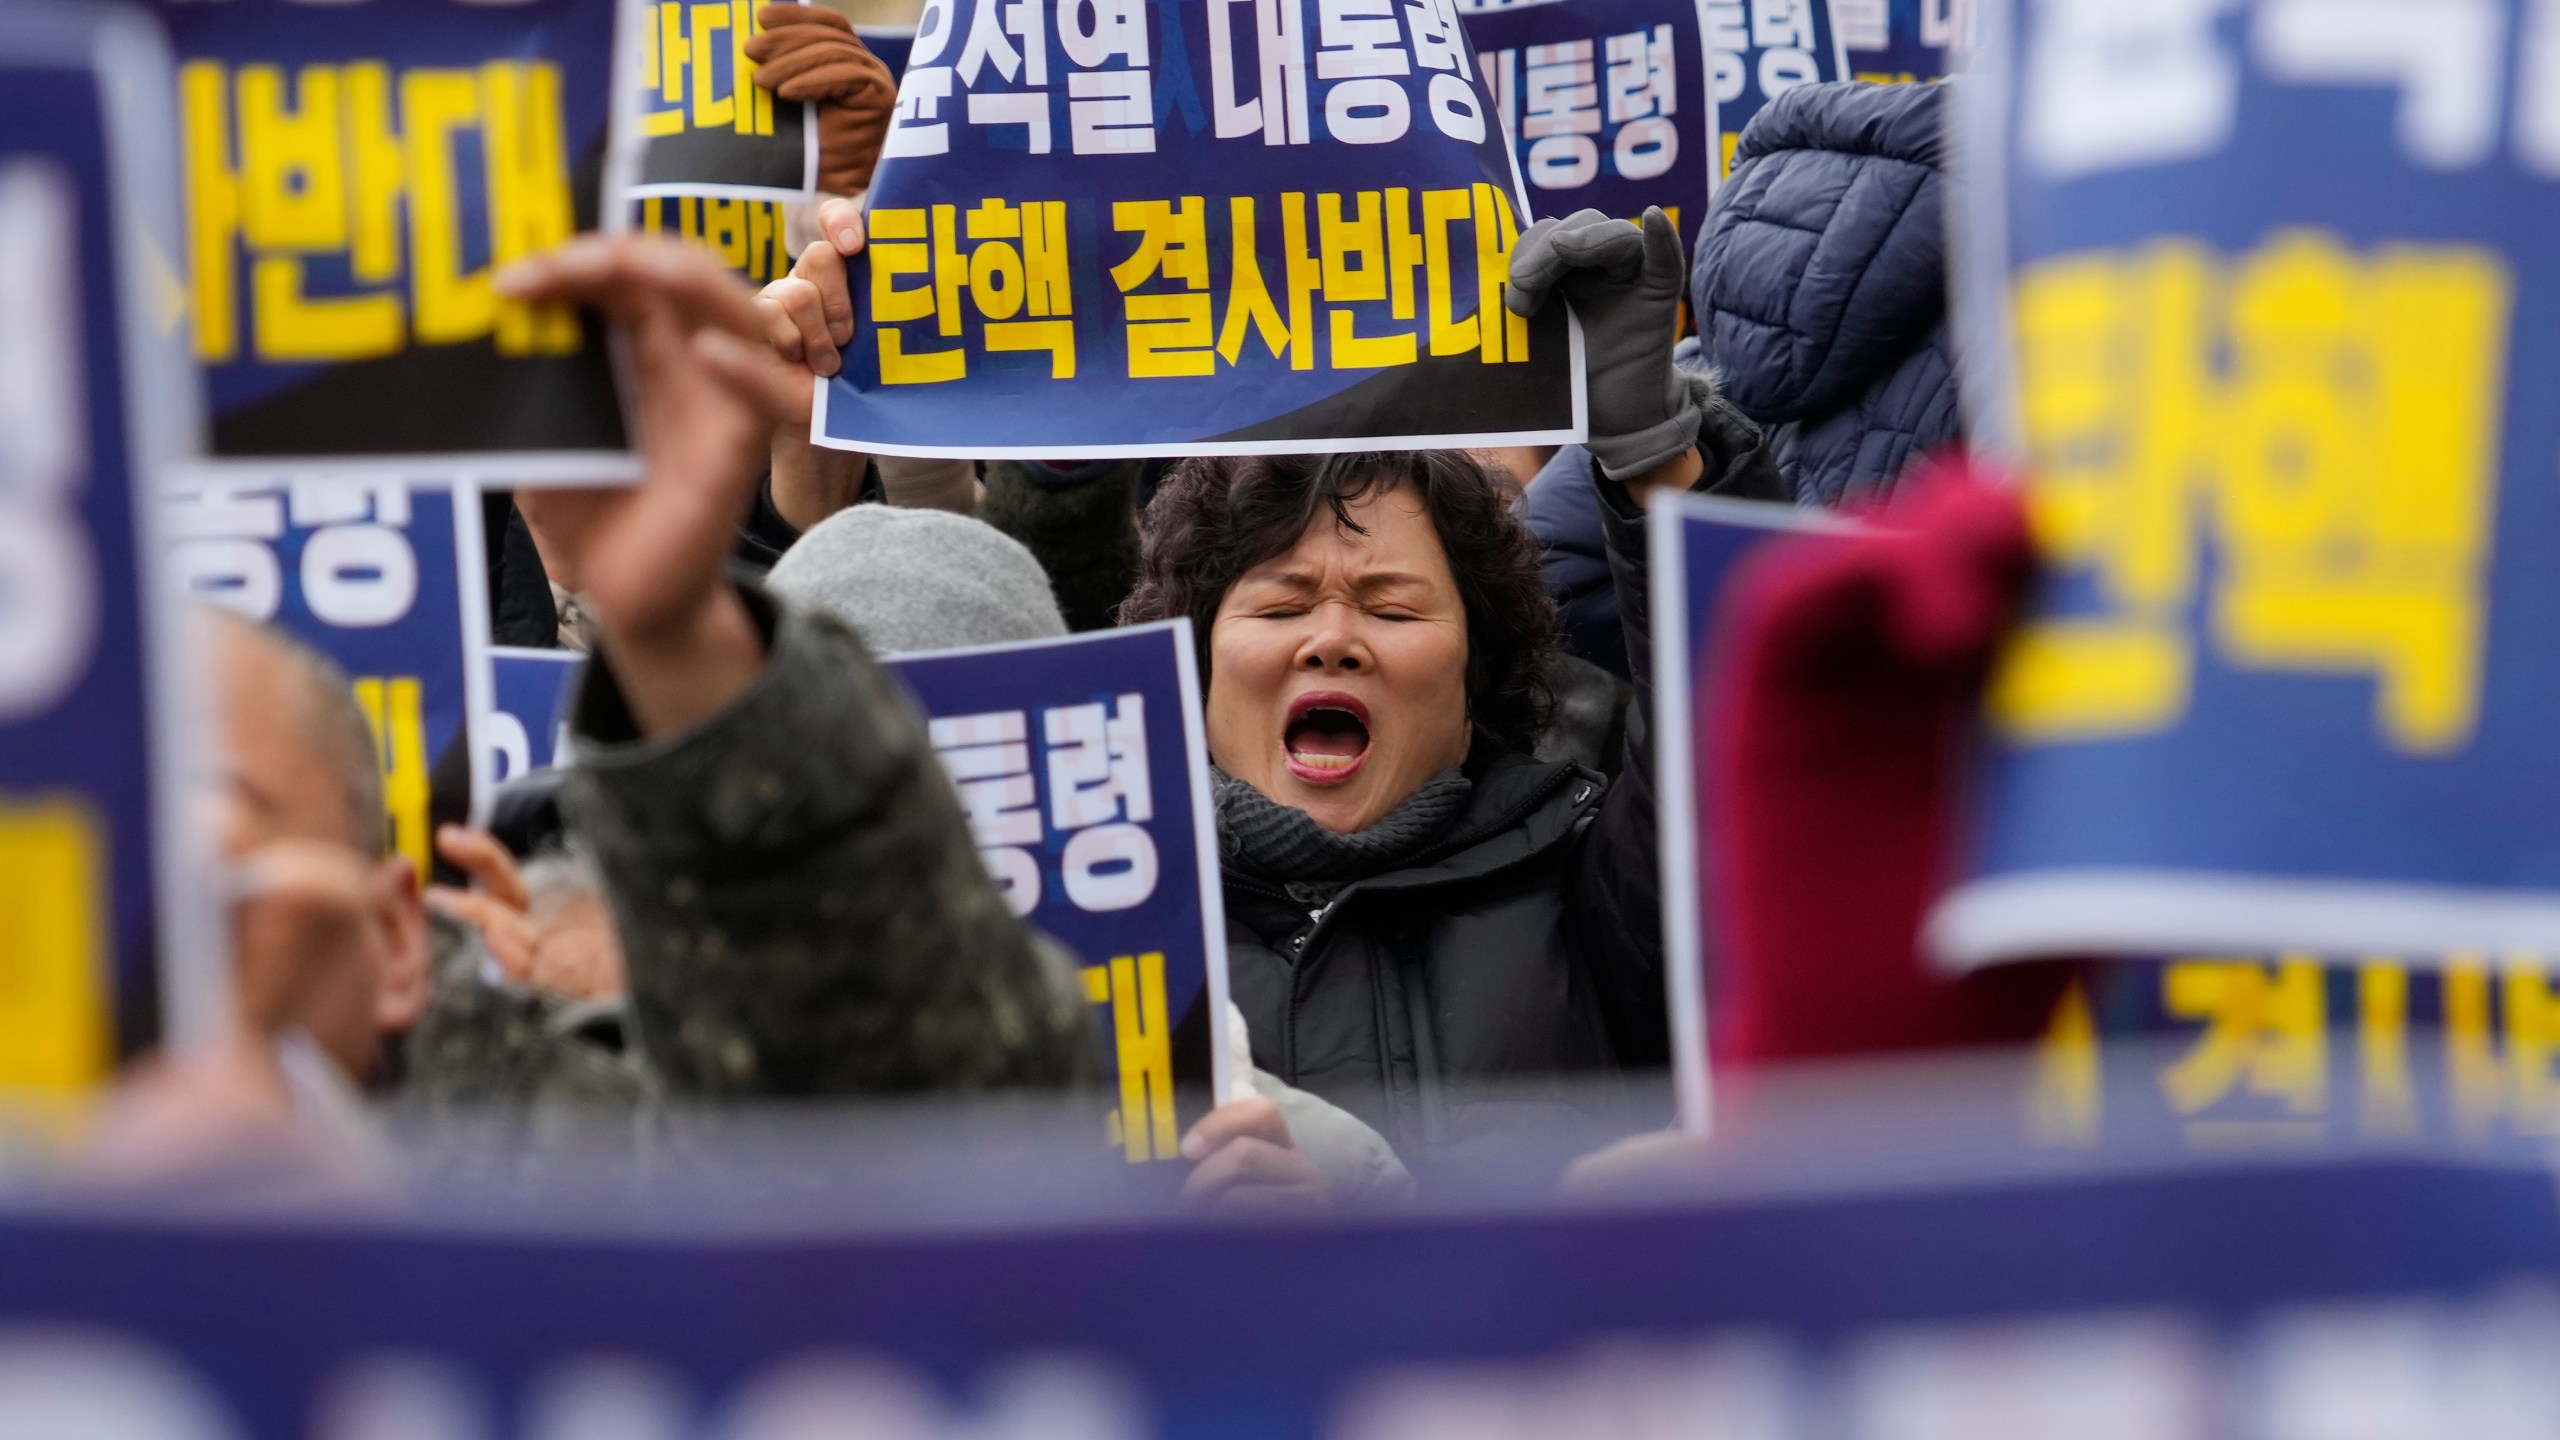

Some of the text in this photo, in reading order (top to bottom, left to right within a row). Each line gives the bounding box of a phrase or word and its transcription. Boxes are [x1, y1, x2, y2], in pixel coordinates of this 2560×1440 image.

[880, 0, 1488, 159] 윤석열 대통령
[868, 197, 1076, 386] 탄핵
[1110, 182, 1530, 379] 결사반대
